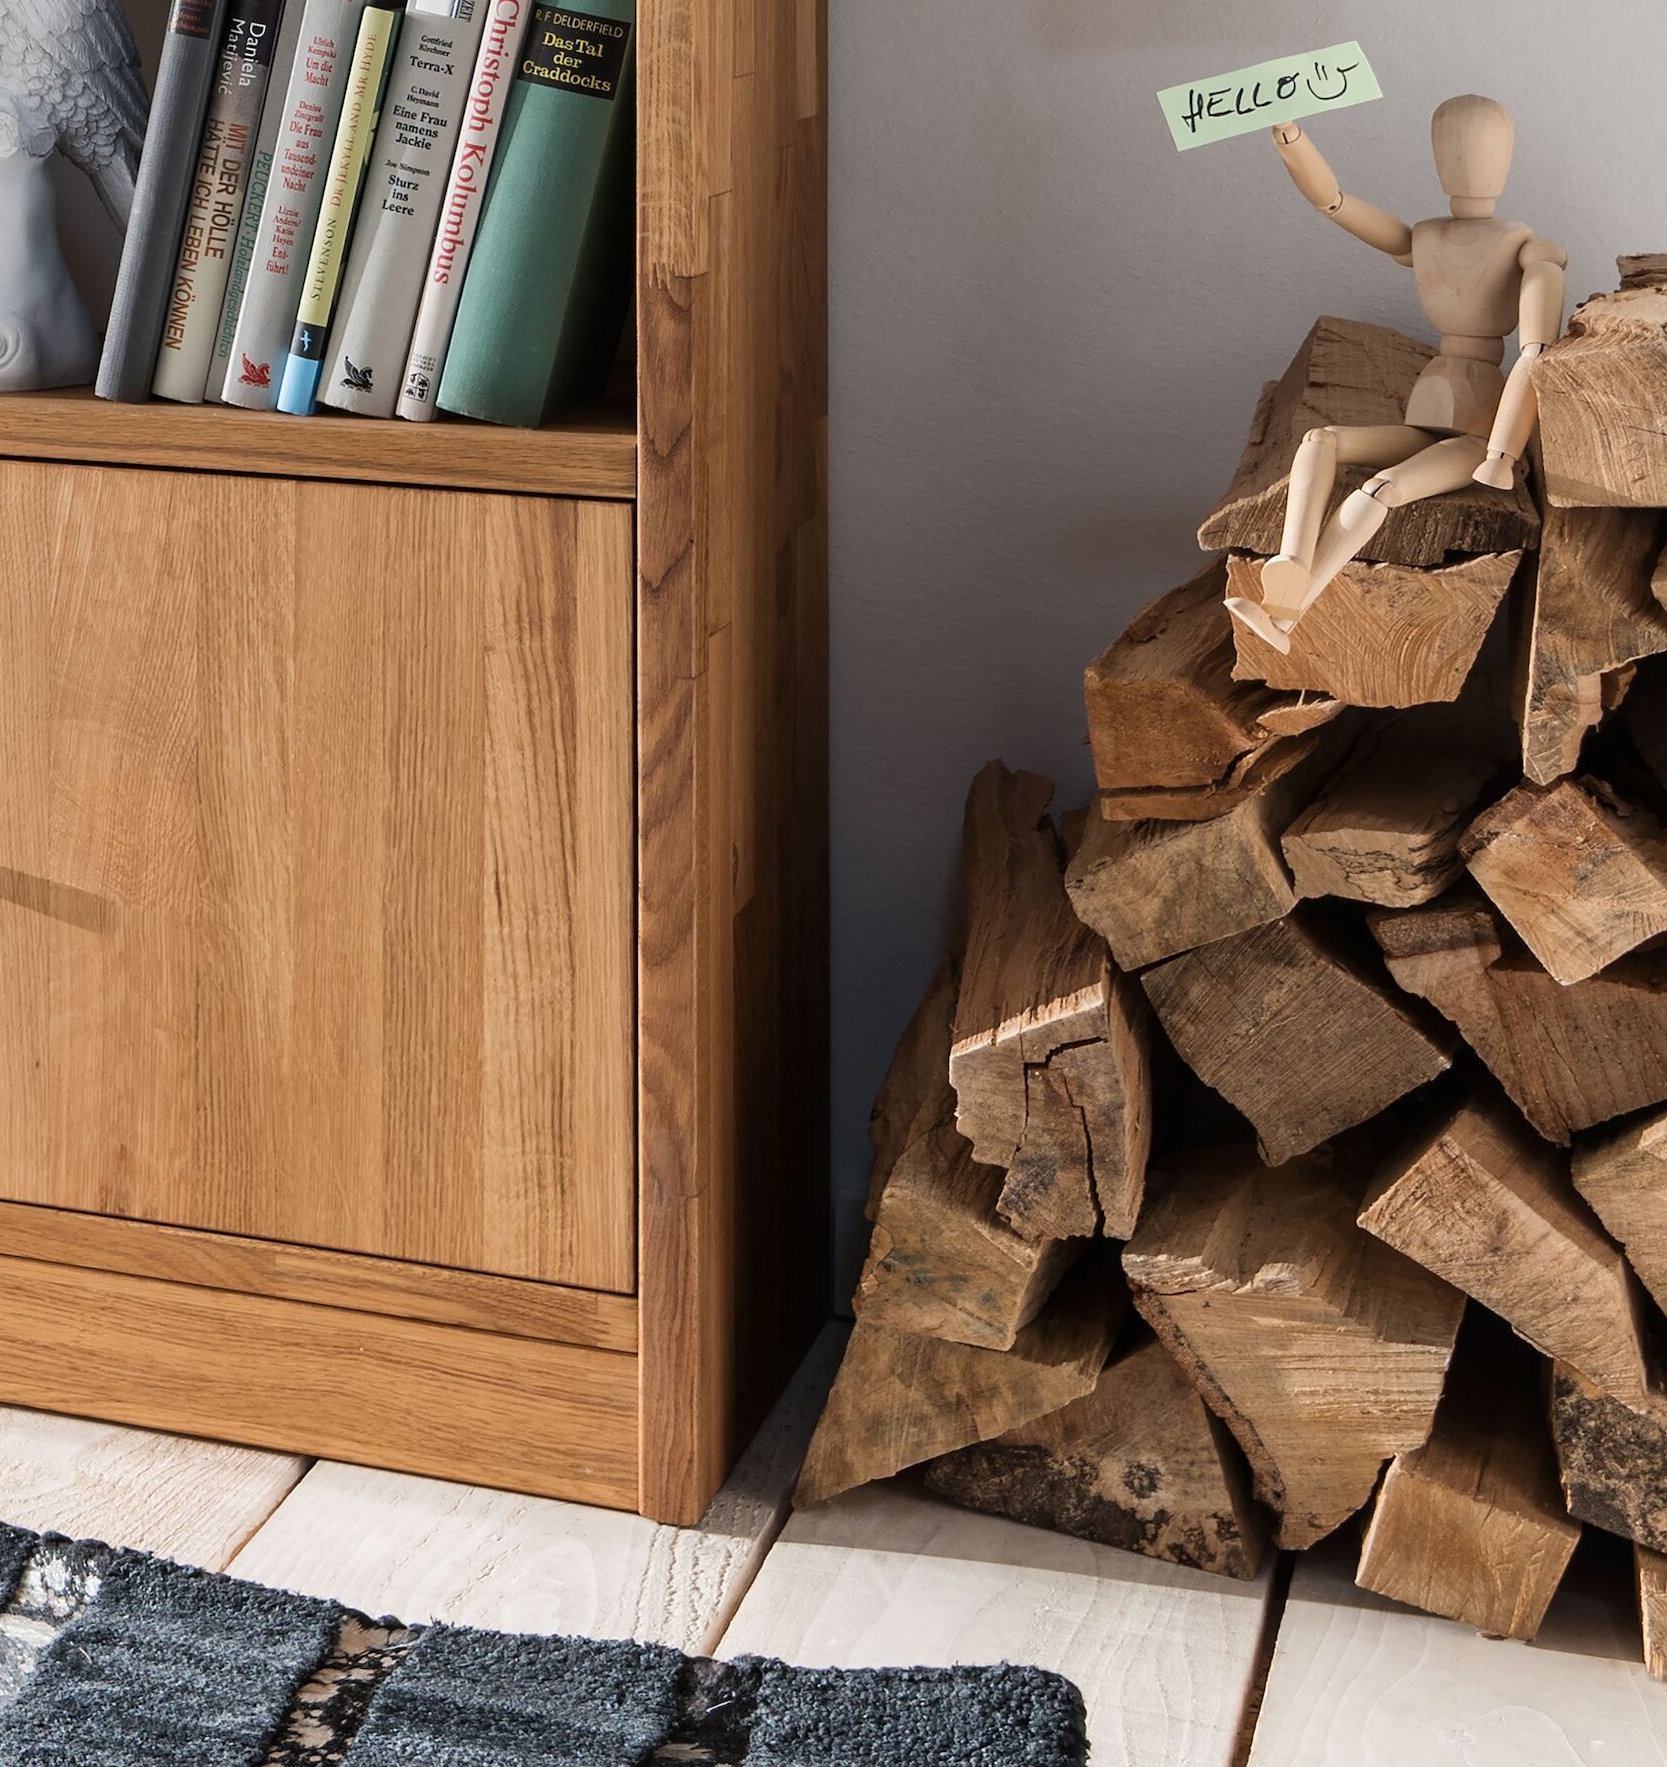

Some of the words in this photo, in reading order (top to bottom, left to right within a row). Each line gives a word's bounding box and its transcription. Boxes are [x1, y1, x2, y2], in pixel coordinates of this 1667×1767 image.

[458, 0, 475, 22] ZEIT
[553, 12, 624, 38] DELDERFIELD
[359, 32, 377, 73] HYDE
[421, 34, 453, 48] Gottfried
[541, 31, 574, 51] Das
[575, 38, 604, 58] Tal
[218, 18, 245, 94] Matijević
[238, 22, 266, 86] Daniela
[306, 57, 319, 69] Um
[321, 61, 333, 73] die
[410, 55, 455, 75] Terra-X
[553, 52, 583, 69] der
[305, 71, 328, 87] Macht
[354, 76, 369, 99] MR
[522, 60, 611, 92] Craddocks
[299, 100, 322, 113] Denise
[1181, 71, 1300, 133] HELLO
[349, 101, 363, 133] AND
[393, 104, 418, 120] Eine
[420, 112, 448, 127] Frau
[226, 123, 250, 154] MIT
[289, 121, 303, 134] Die
[305, 124, 323, 138] Frau
[395, 122, 438, 138] namens
[199, 119, 226, 175] HÄTTE
[296, 139, 310, 149] aus
[395, 133, 432, 150] Jackie
[284, 148, 317, 165] Tausend-
[335, 135, 355, 185] JEKYLL
[217, 158, 242, 196] DER
[281, 164, 314, 180] undeiner
[398, 163, 430, 176] Simpson
[244, 150, 272, 231] PEUCKERT
[283, 177, 306, 192] Nacht
[388, 174, 419, 191] Sturz
[193, 179, 213, 210] ICH
[330, 188, 344, 207] DR
[392, 188, 409, 202] ins
[382, 199, 415, 216] Leere
[434, 141, 488, 284] Kolumbus
[205, 200, 235, 259] HÖLLE
[181, 214, 206, 272] LEBEN
[310, 217, 337, 301] STEVENSON
[164, 275, 196, 350] KÖNNEN
